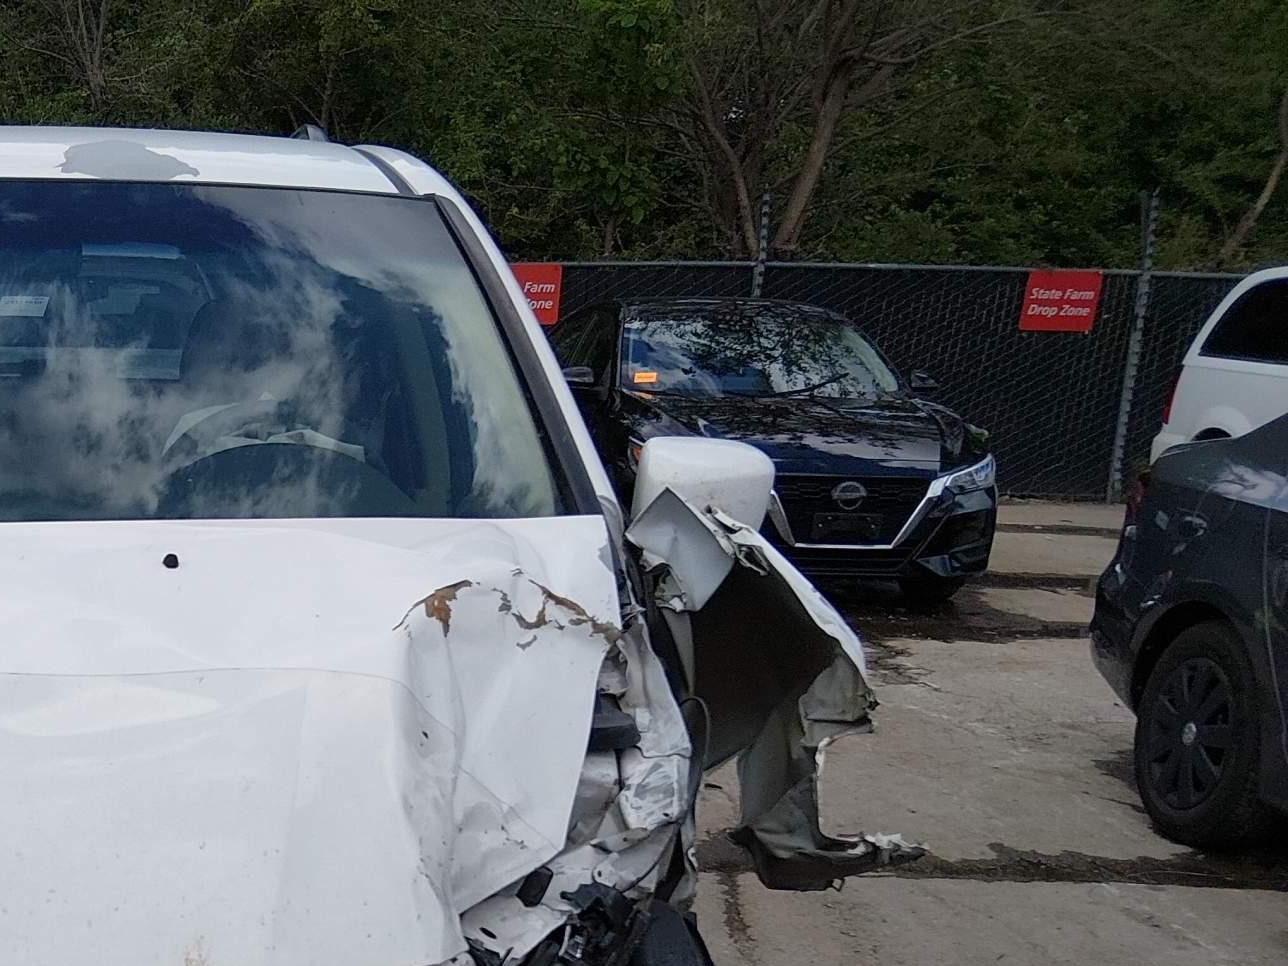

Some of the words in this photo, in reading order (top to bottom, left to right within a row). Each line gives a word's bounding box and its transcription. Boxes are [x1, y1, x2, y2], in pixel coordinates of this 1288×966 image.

[523, 281, 556, 293] Farm
[1029, 287, 1063, 300] State
[1063, 288, 1096, 300] Farm
[527, 298, 554, 310] one
[1026, 303, 1058, 318] Drop
[1059, 304, 1091, 316] Zone
